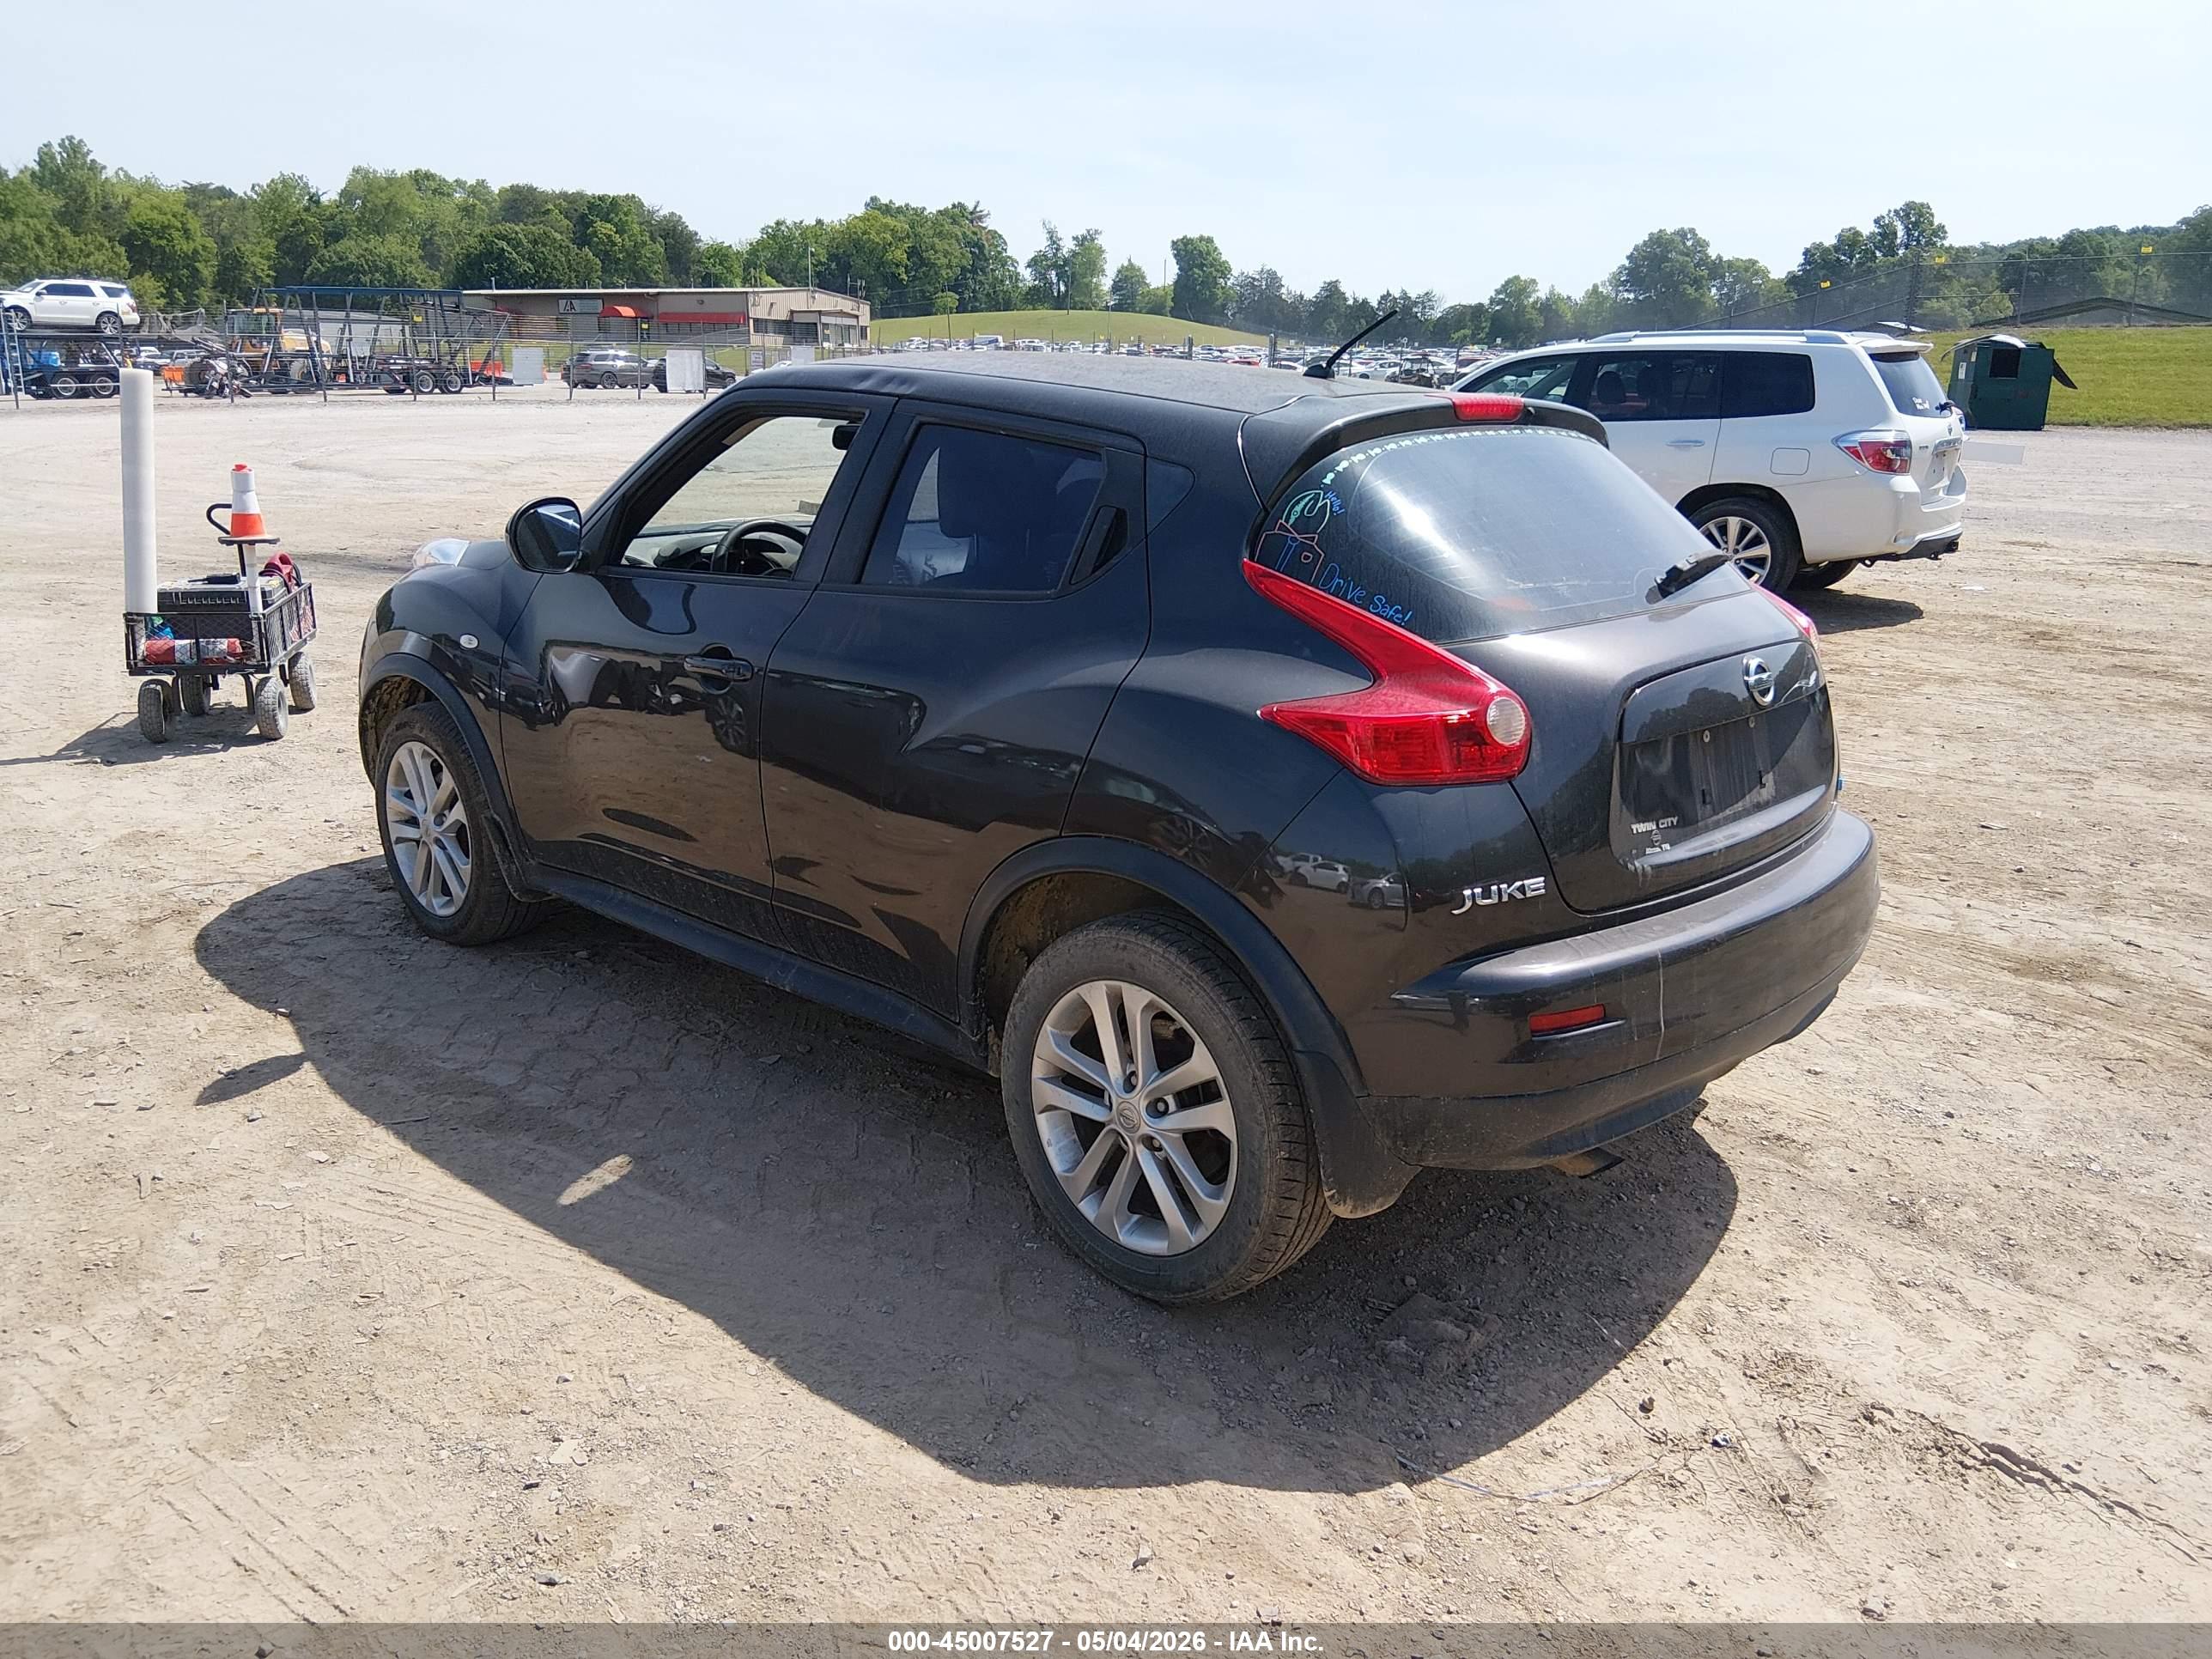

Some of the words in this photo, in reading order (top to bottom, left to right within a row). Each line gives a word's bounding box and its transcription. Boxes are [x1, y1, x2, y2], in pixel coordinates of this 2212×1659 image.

[1324, 490, 1346, 516] Hello!
[1318, 562, 1366, 604] Drive
[1370, 594, 1413, 626] Safe!
[1631, 820, 1657, 834] TWIN
[1658, 816, 1679, 829] CITY
[1450, 876, 1546, 915] JUKE
